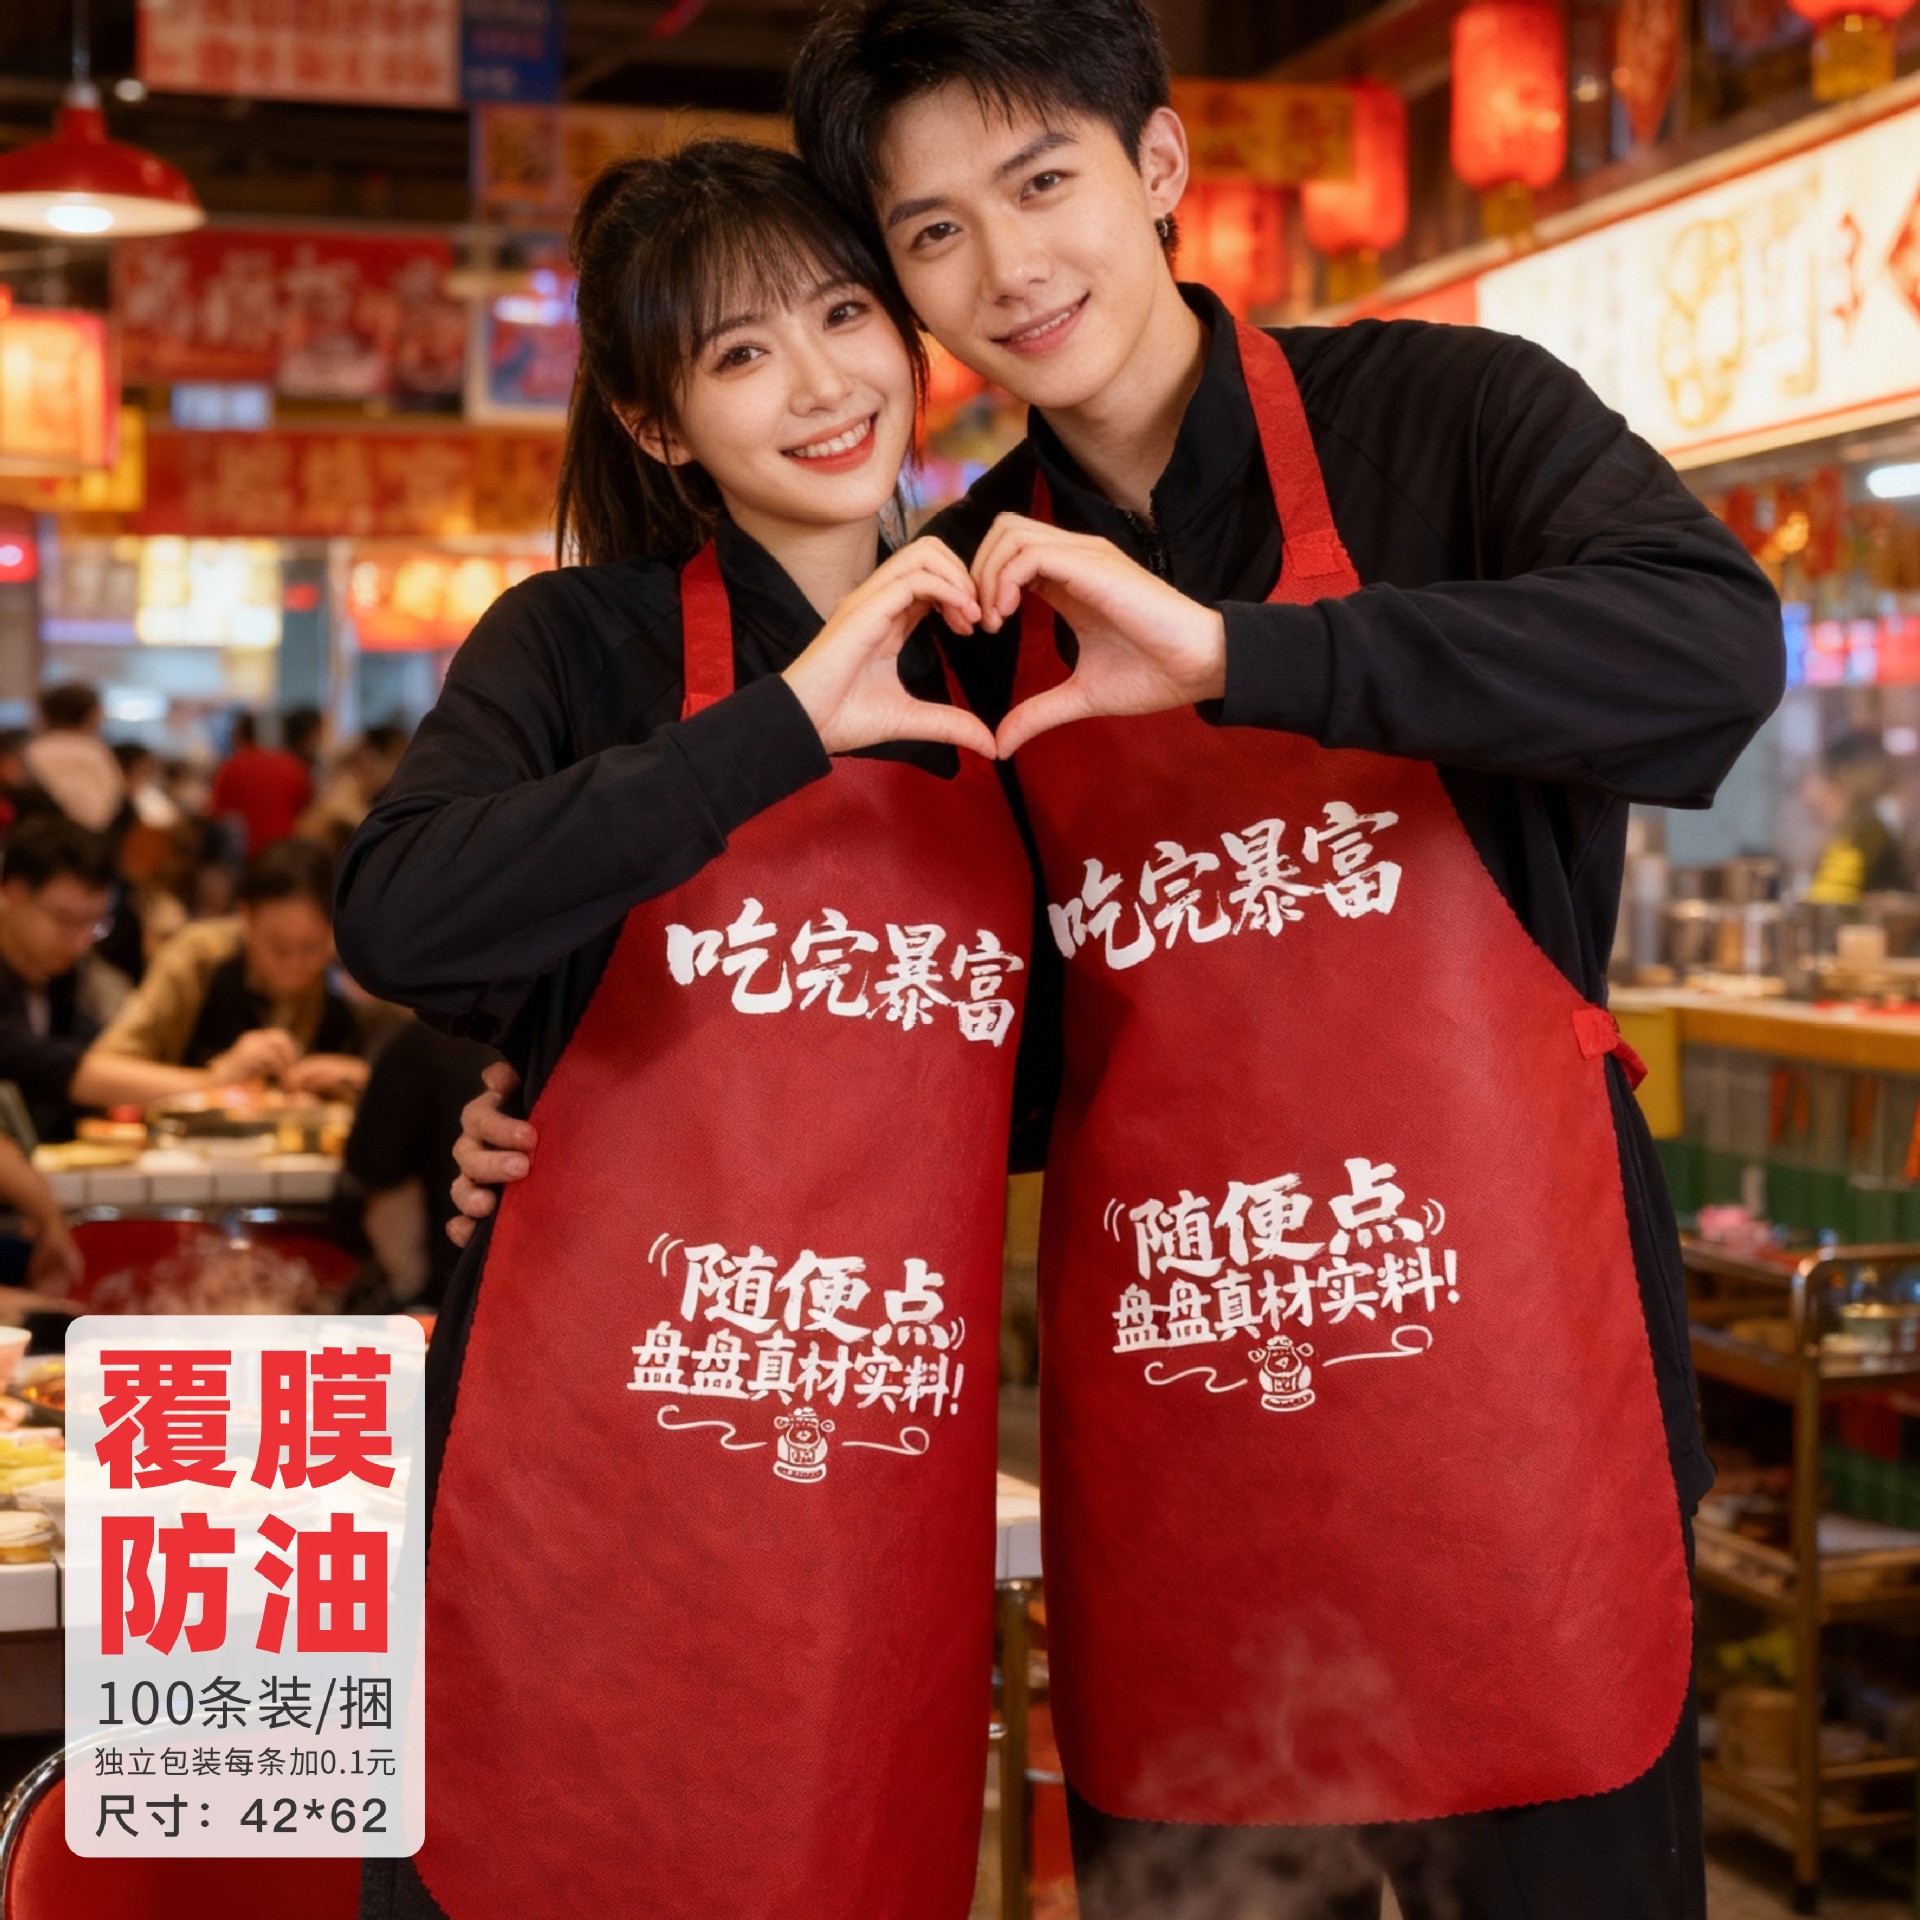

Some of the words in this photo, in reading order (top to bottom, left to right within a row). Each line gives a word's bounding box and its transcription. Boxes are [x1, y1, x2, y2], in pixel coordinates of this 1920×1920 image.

[1049, 801, 1402, 969] 吃完暴富
[665, 897, 1024, 1047] 吃完暴富
[1129, 1157, 1424, 1280] 随便点
[680, 1243, 949, 1349] 随便点
[1112, 1247, 1460, 1353] 盘盘真材实料!
[626, 1320, 965, 1417] 盘盘真材实料!
